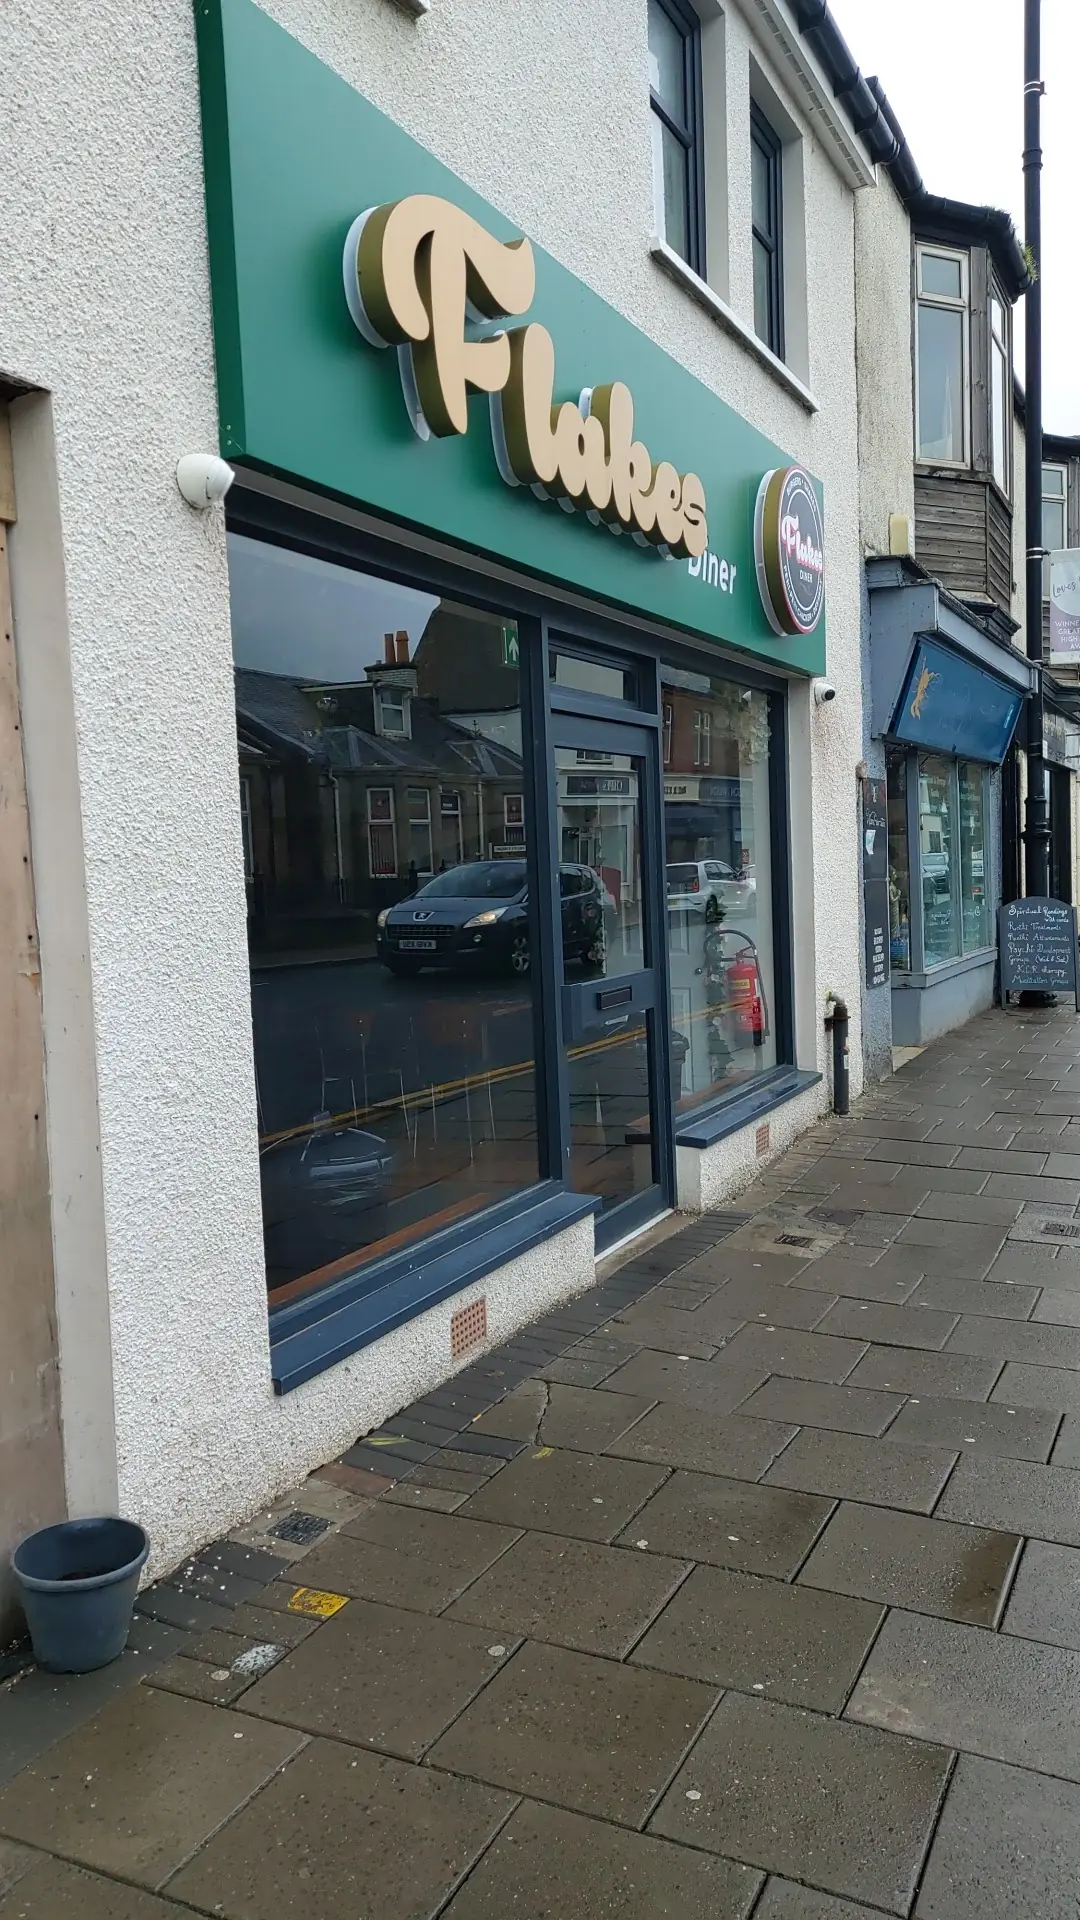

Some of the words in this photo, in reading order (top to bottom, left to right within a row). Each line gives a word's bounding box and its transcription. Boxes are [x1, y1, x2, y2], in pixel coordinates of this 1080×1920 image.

[364, 194, 708, 559] Flakes
[800, 569, 813, 583] DINER
[1009, 905, 1042, 918] Spiritual
